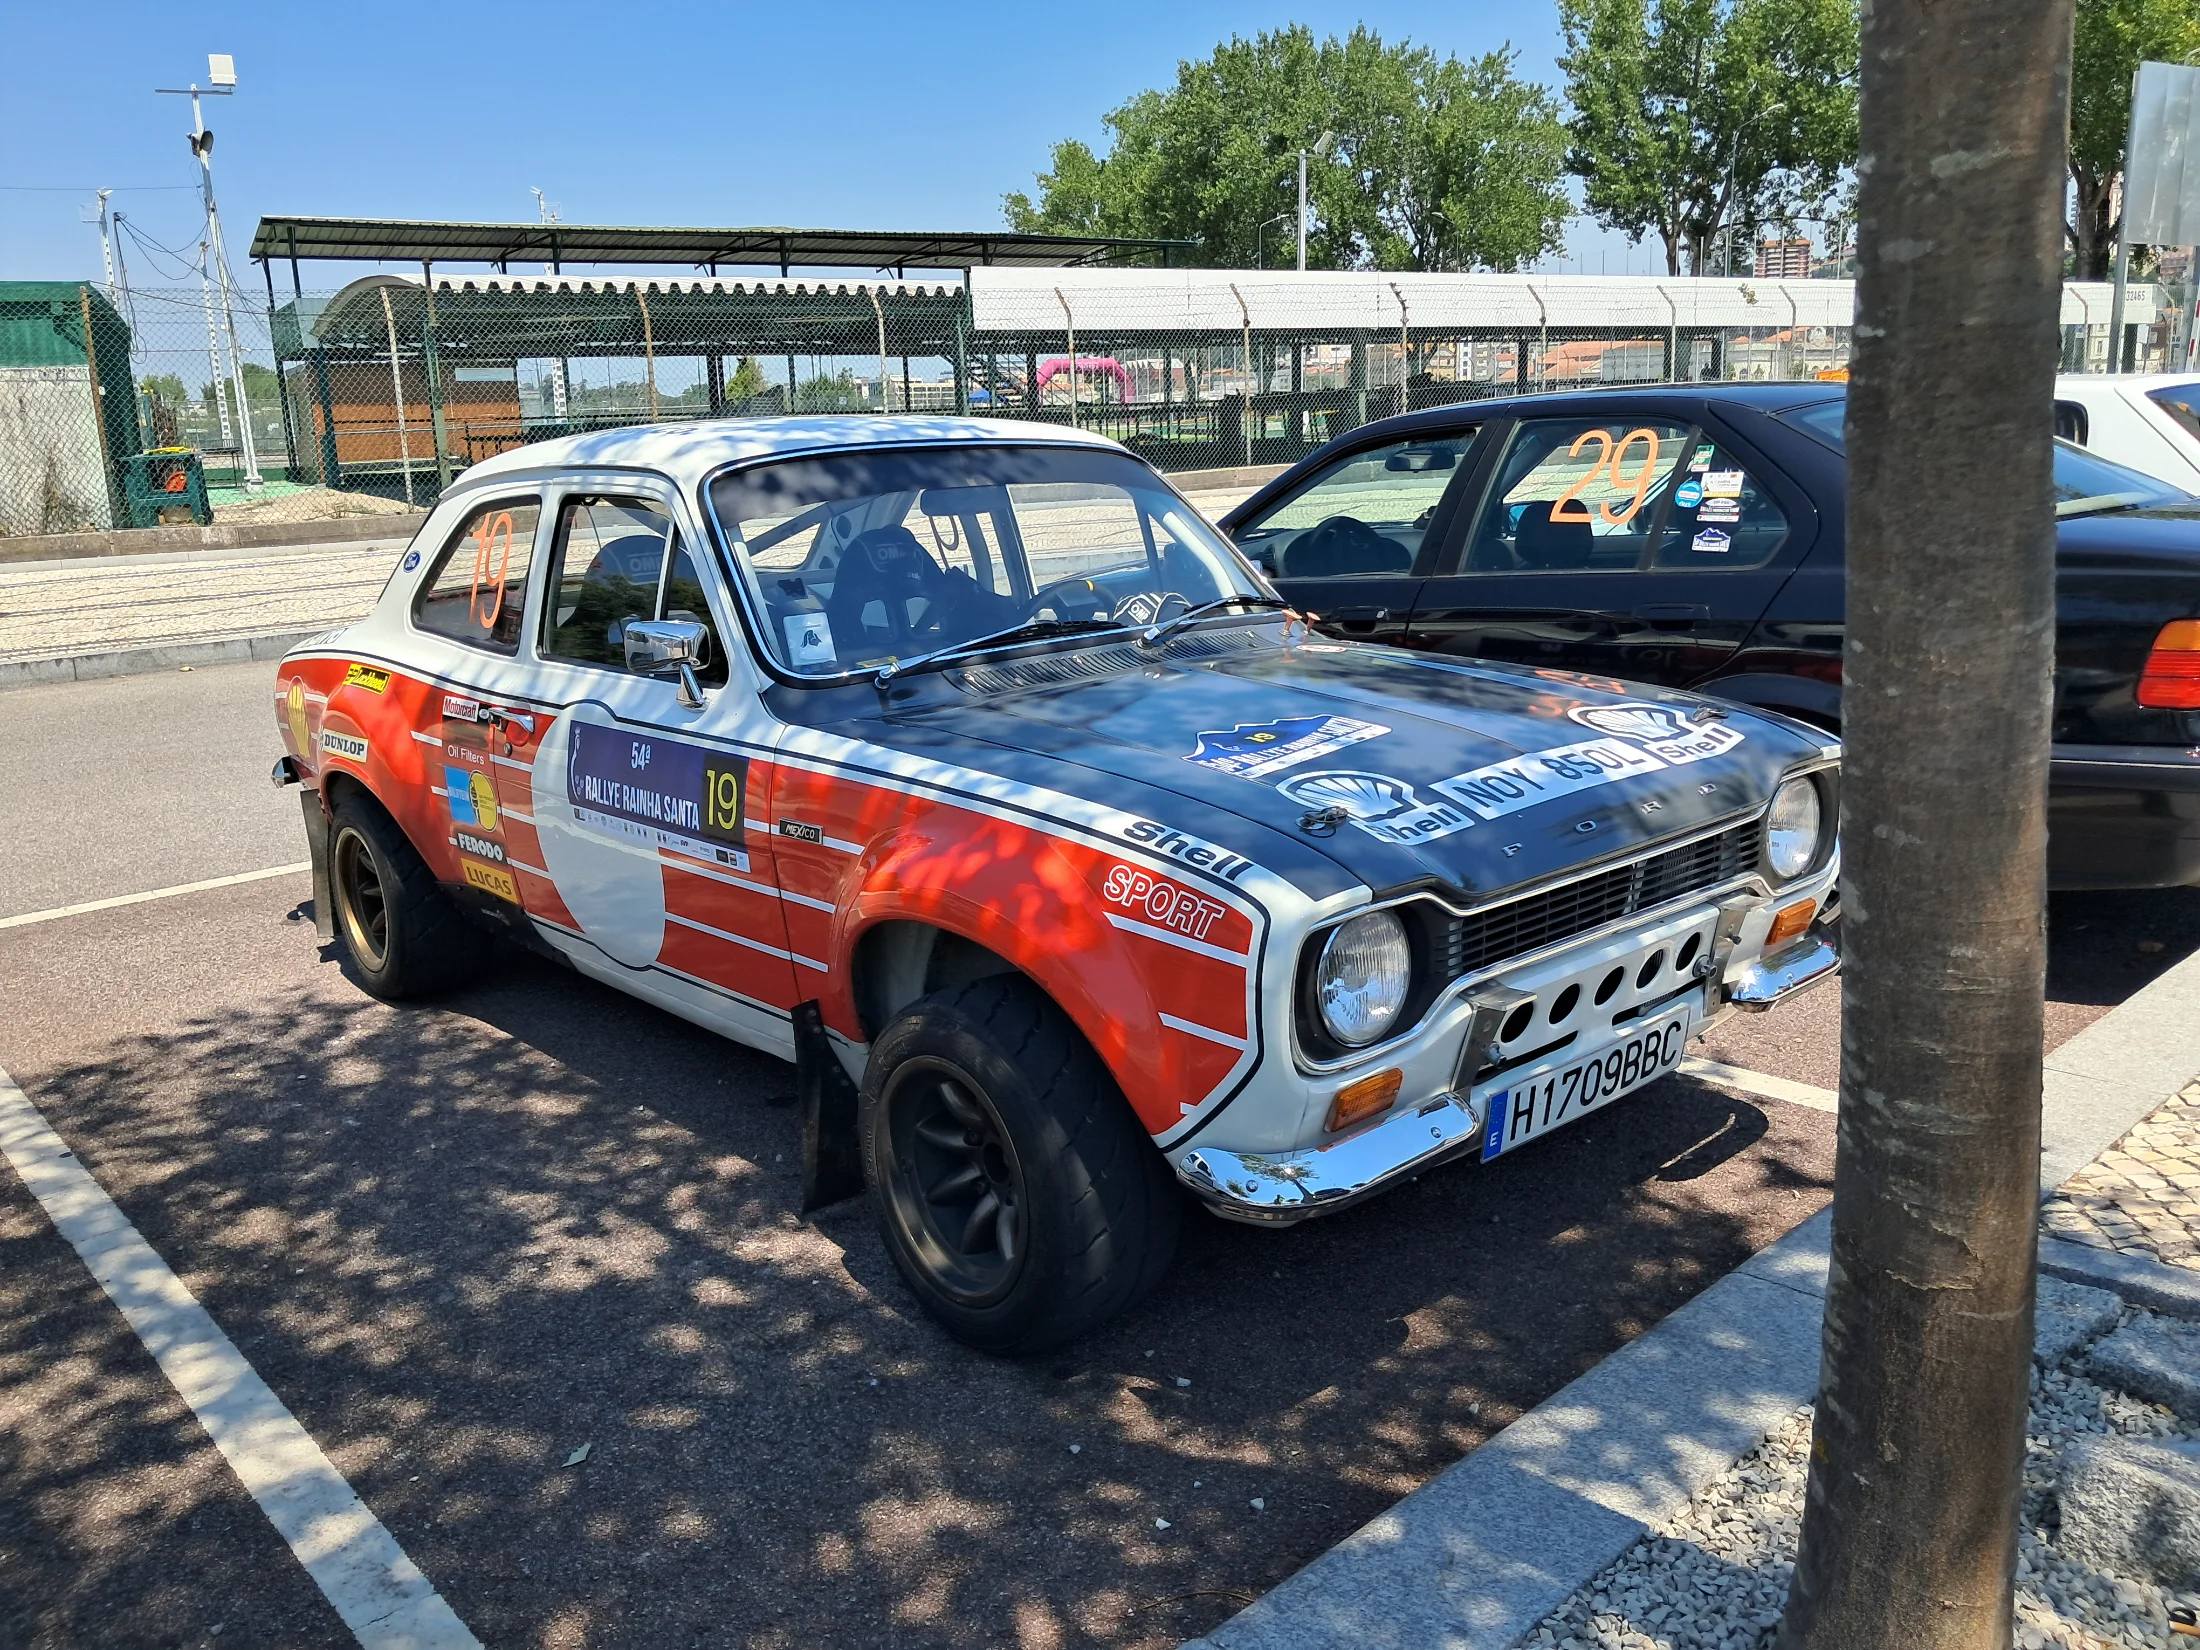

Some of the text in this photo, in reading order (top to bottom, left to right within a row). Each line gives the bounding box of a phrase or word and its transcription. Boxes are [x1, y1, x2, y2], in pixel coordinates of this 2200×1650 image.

[1549, 428, 1659, 525] 29
[470, 512, 513, 629] 19
[1130, 603, 1149, 621] OMP
[443, 698, 477, 720] Motorcraft
[324, 733, 365, 756] DUNLOP
[447, 744, 485, 765] Oil Filters
[1658, 727, 1735, 758] Shell
[1452, 746, 1647, 808] NOY 850L
[585, 775, 621, 807] RALLYE
[622, 784, 662, 820] RAINHA
[663, 796, 700, 831] SANTA
[706, 769, 739, 830] 19
[1501, 783, 1718, 857] FORD
[457, 832, 504, 862] FERODO
[785, 823, 815, 840] MEXICO
[1123, 820, 1255, 881] Shell
[466, 866, 513, 896] LUCAS
[1102, 864, 1226, 940] SPORT
[1509, 1020, 1682, 1142] H1709BBC
[1489, 1132, 1499, 1147] E
